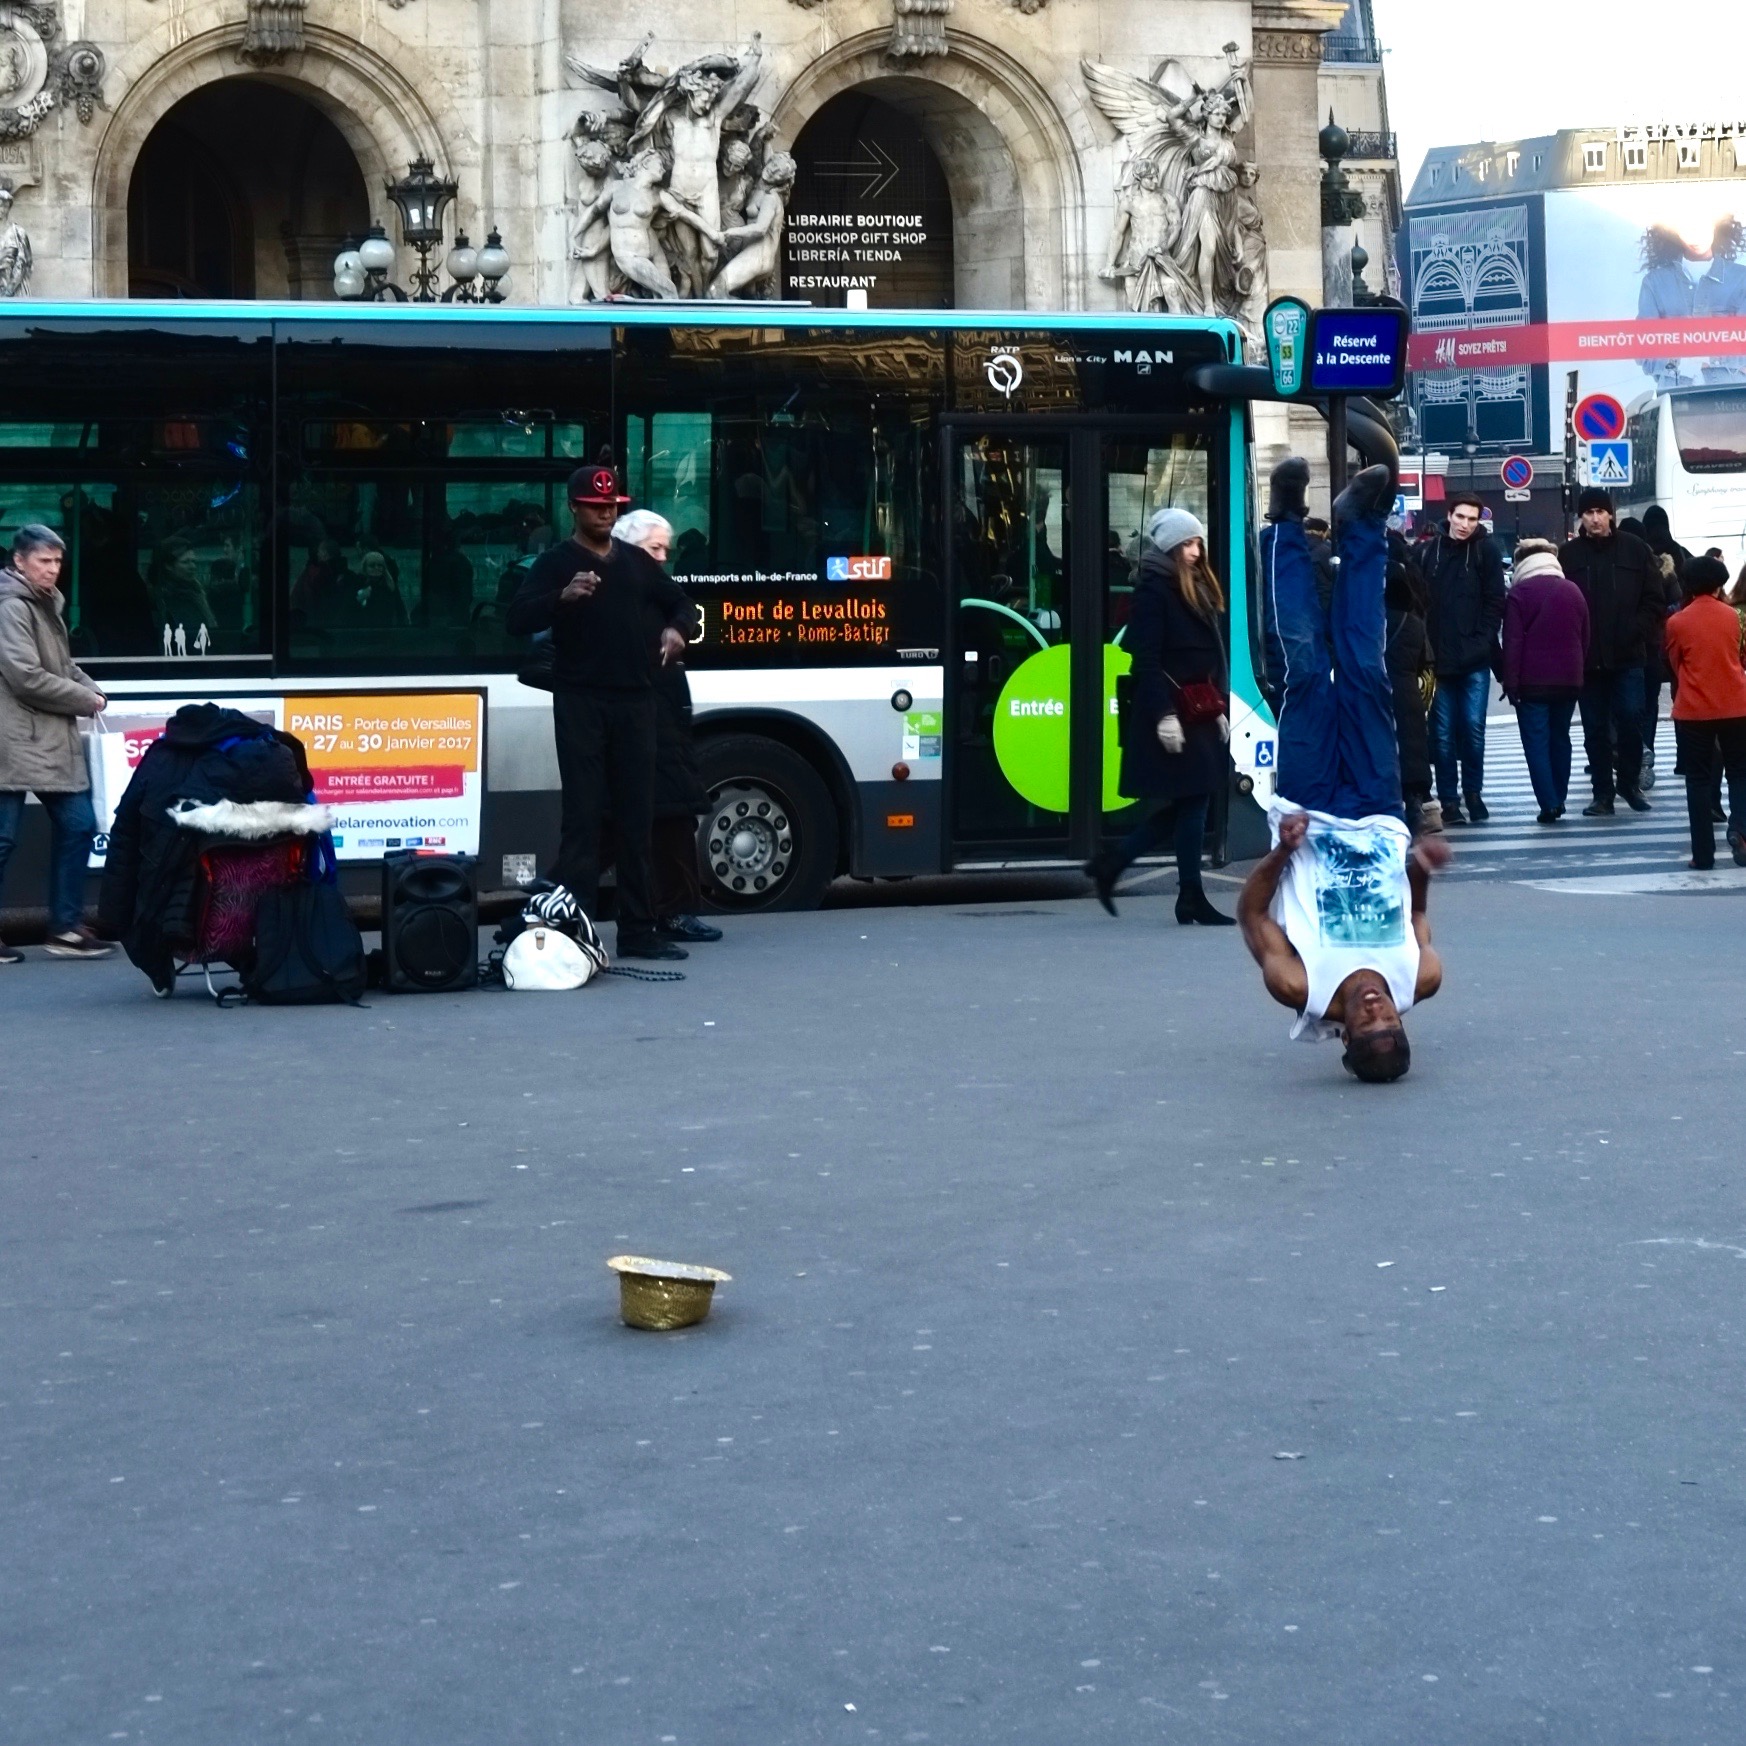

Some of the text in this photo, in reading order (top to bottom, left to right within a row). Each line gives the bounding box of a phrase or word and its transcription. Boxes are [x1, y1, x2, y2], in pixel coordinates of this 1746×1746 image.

[788, 214, 923, 227] LIBRAIRIE BOUTIQUE
[788, 232, 927, 245] BOOKSHOP GIFT SHOP
[788, 247, 902, 262] LIBRERÍA TIENDA
[789, 276, 877, 288] RESTAURANT
[1288, 320, 1298, 334] 22
[1333, 335, 1377, 348] Réservé
[1578, 331, 1746, 347] BIENTÔT VOTRE NOUVEAU
[990, 346, 1020, 354] RATP
[1282, 345, 1292, 359] 53
[1458, 342, 1481, 355] SOYEZ
[1482, 339, 1507, 353] PRÊTS!
[1086, 356, 1107, 364] City
[1113, 350, 1174, 364] MAN
[1316, 353, 1391, 365] à la Descente
[1282, 371, 1293, 384] 66
[852, 557, 891, 578] stif
[690, 573, 740, 584] transports
[741, 574, 753, 583] en
[755, 570, 818, 582] Île-de-France
[723, 599, 886, 621] Pont de Levallois
[720, 625, 780, 644] -Lazare
[1010, 699, 1064, 716] Entrée
[291, 715, 343, 731] PARIS
[354, 718, 388, 730] Porte
[391, 718, 408, 730] de
[410, 717, 472, 730] Versailles
[313, 735, 338, 752] 27
[340, 740, 353, 749] au
[357, 734, 382, 752] 30
[385, 735, 435, 752] janvier
[438, 737, 471, 749] 2017
[328, 773, 371, 786] ENTRÉE
[373, 776, 428, 785] GRATUITE
[333, 818, 468, 828] delarenovation.com
